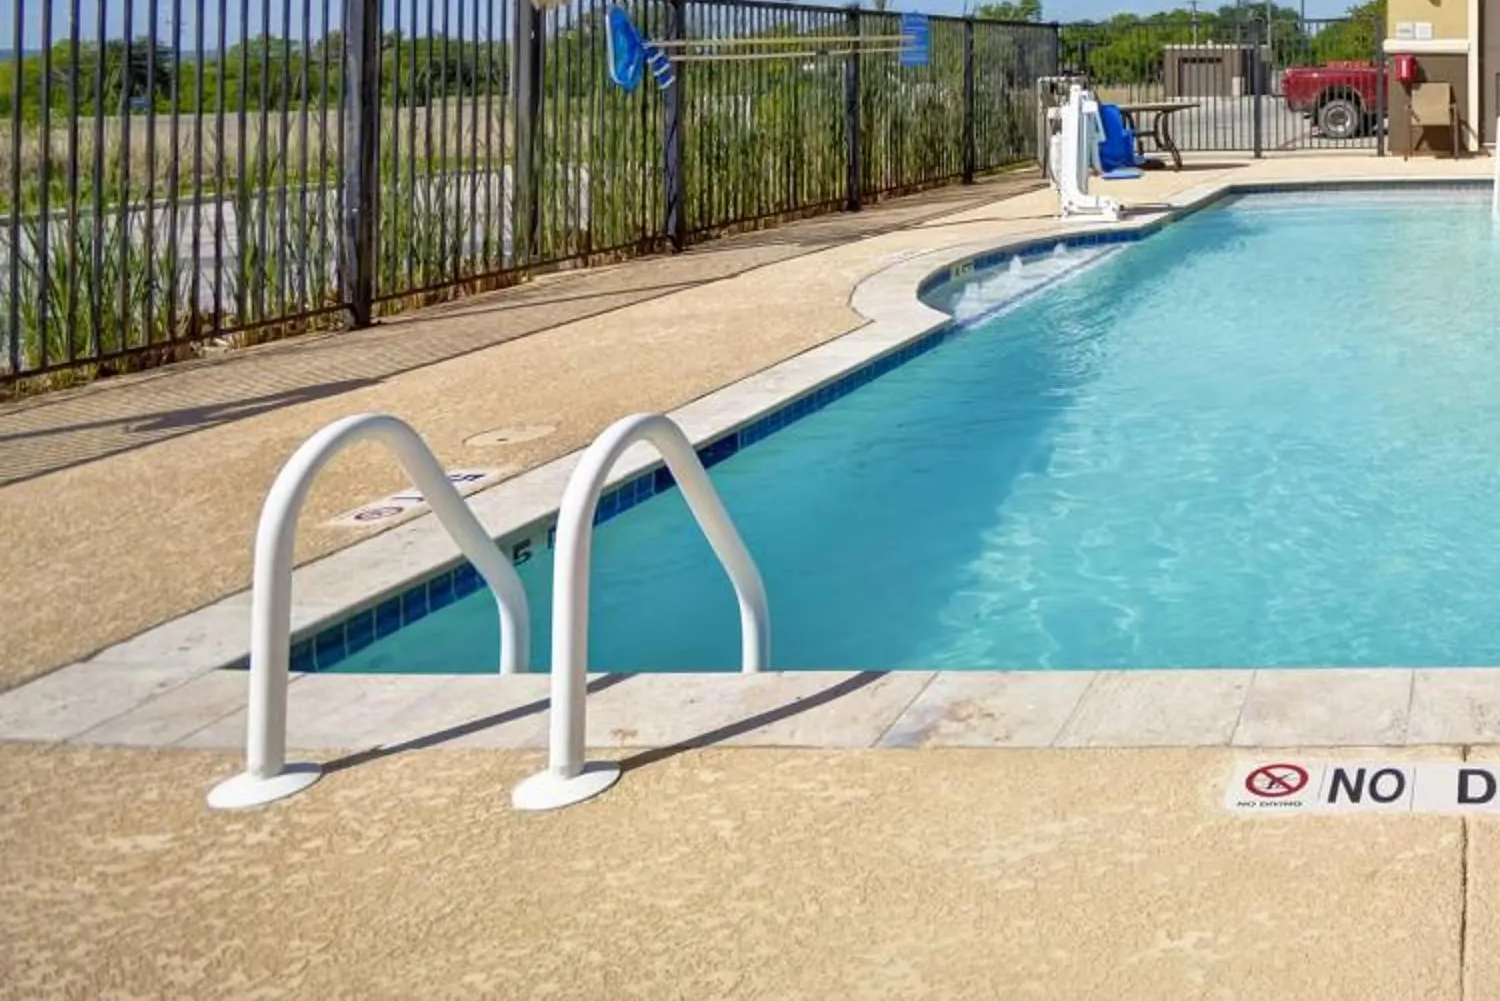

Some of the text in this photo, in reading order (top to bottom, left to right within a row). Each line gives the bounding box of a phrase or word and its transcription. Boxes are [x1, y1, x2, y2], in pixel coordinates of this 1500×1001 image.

[512, 539, 532, 567] 5
[1327, 766, 1406, 805] NO
[1236, 800, 1304, 808] NO DIVING
